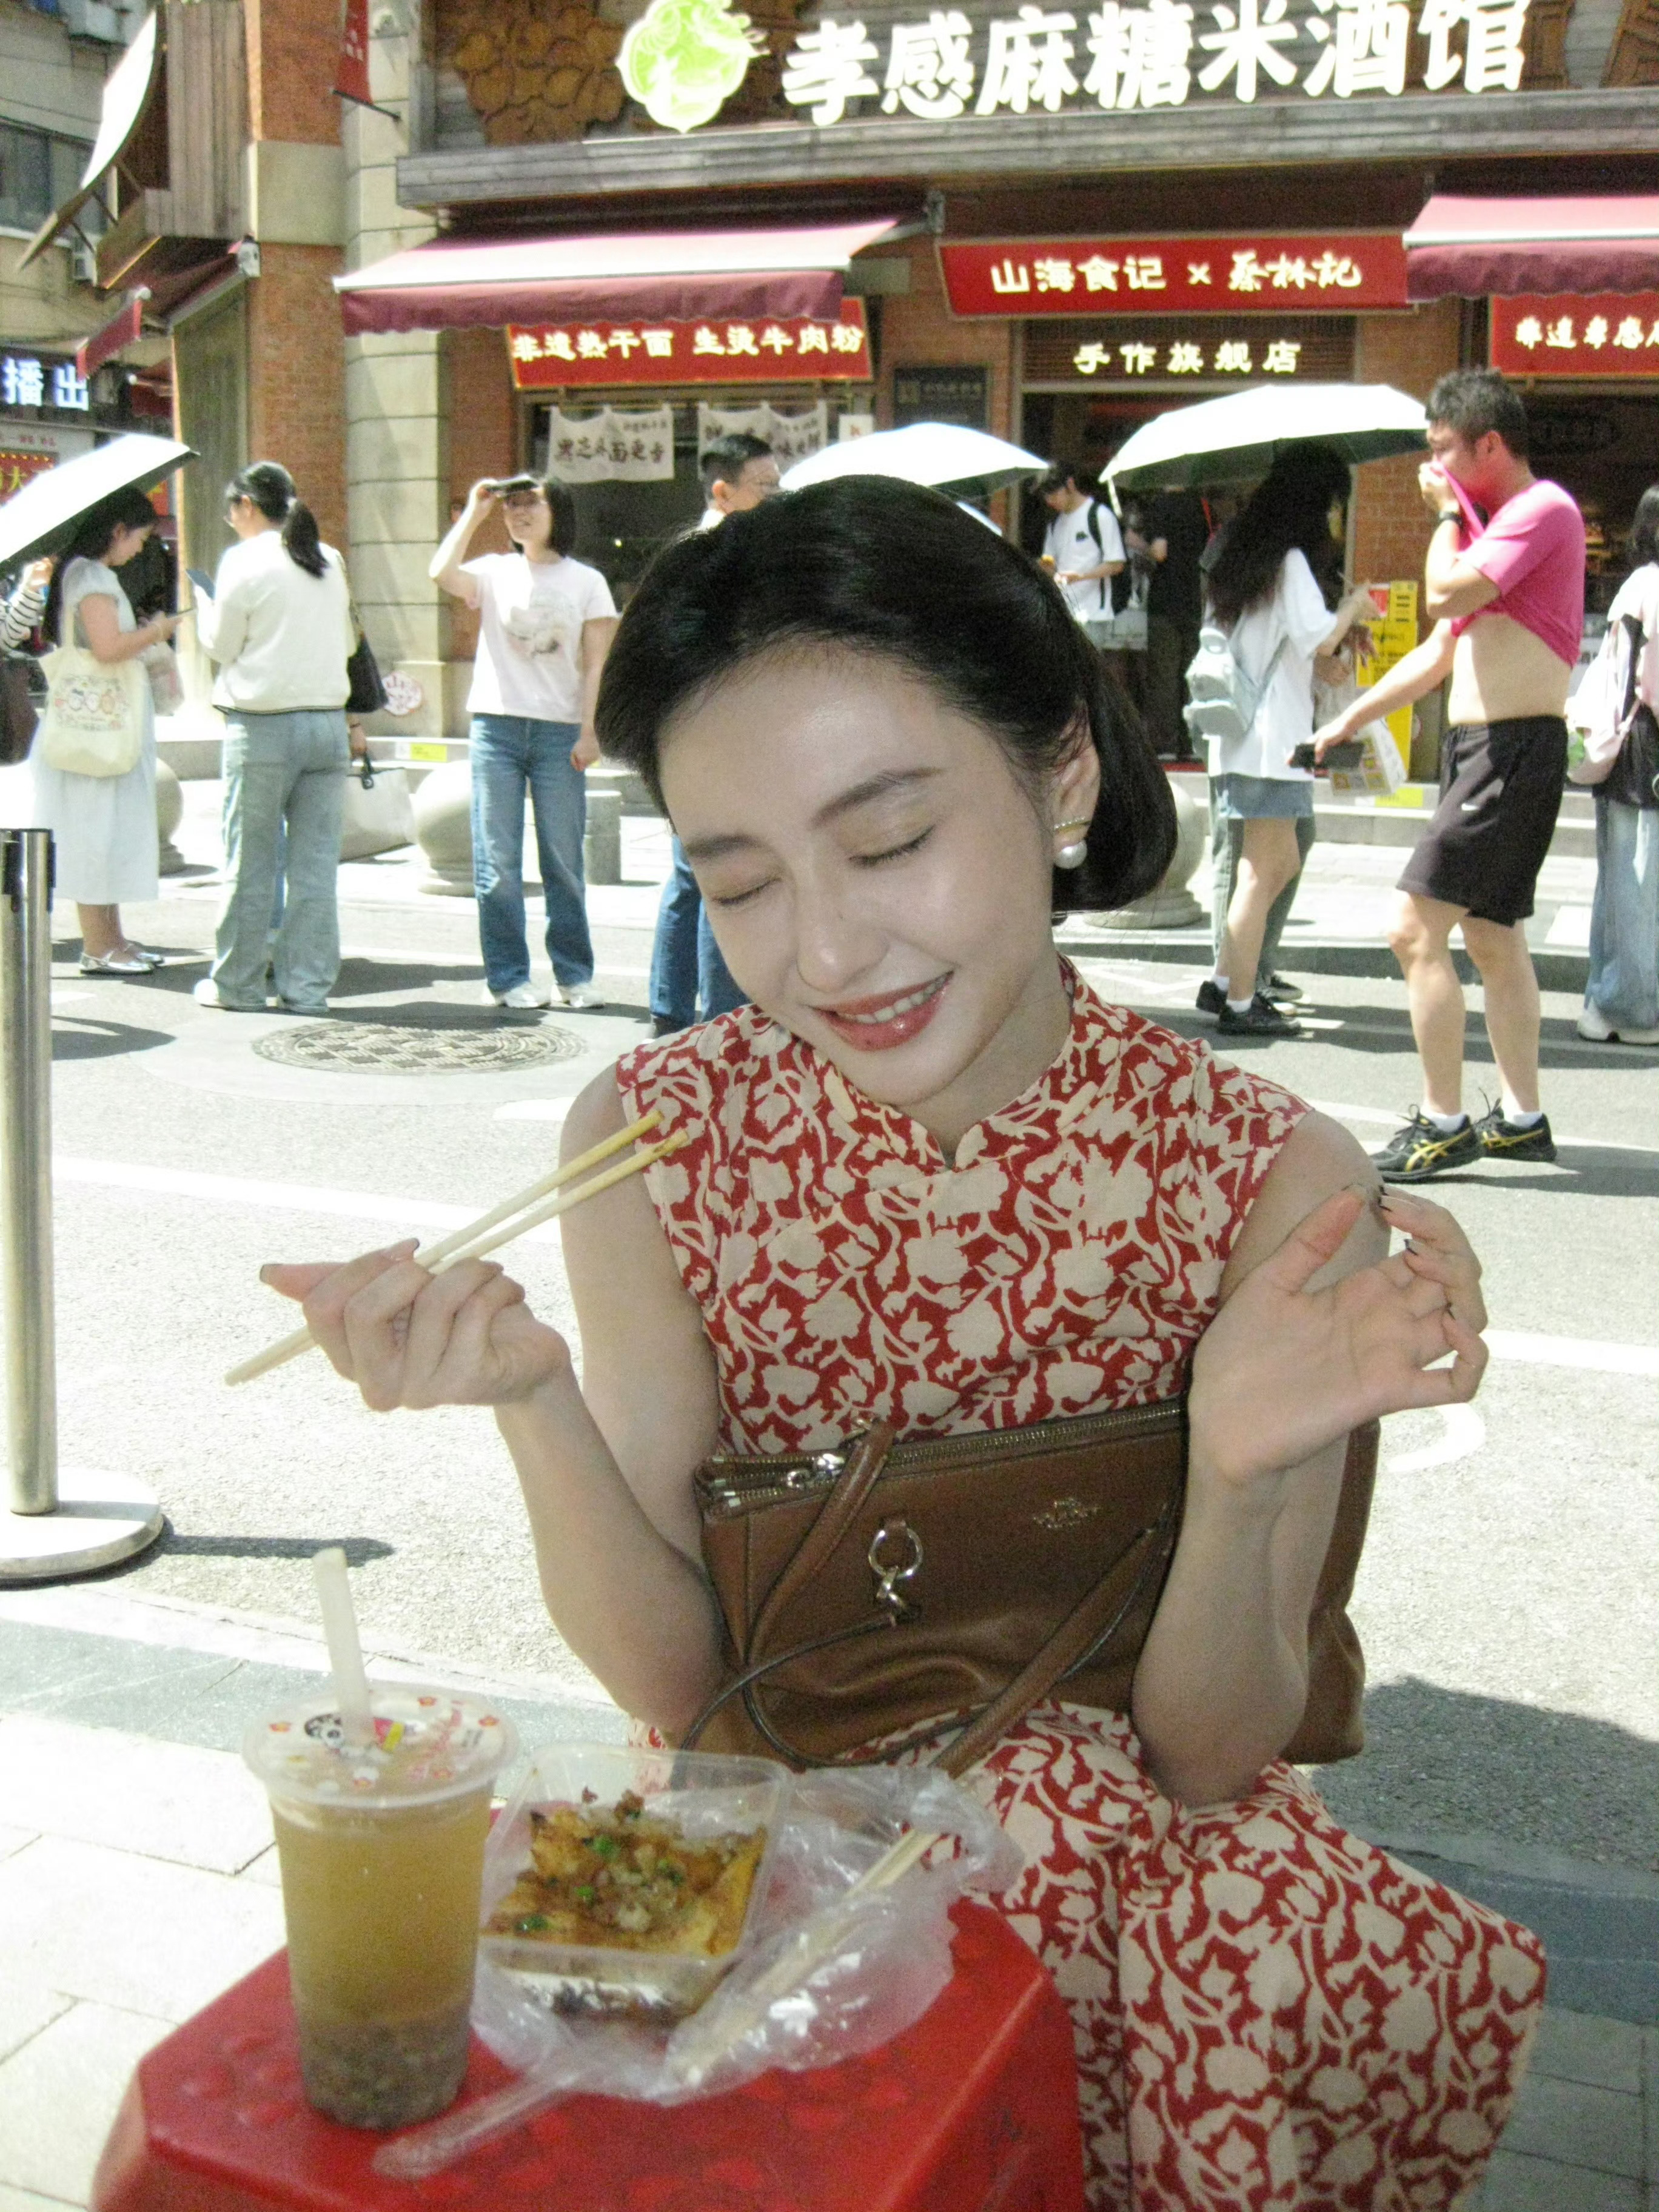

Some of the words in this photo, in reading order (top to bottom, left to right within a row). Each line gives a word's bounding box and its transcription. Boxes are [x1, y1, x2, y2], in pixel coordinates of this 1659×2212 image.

[781, 0, 1530, 126] 孝感麻糖米酒馆
[990, 256, 1166, 293] 山海食记
[512, 330, 674, 361] 非遗热干面
[693, 325, 863, 355] 生烫牛肉粉
[1515, 315, 1659, 350] 非遗孝感
[1073, 341, 1302, 374] 手作旗舰店
